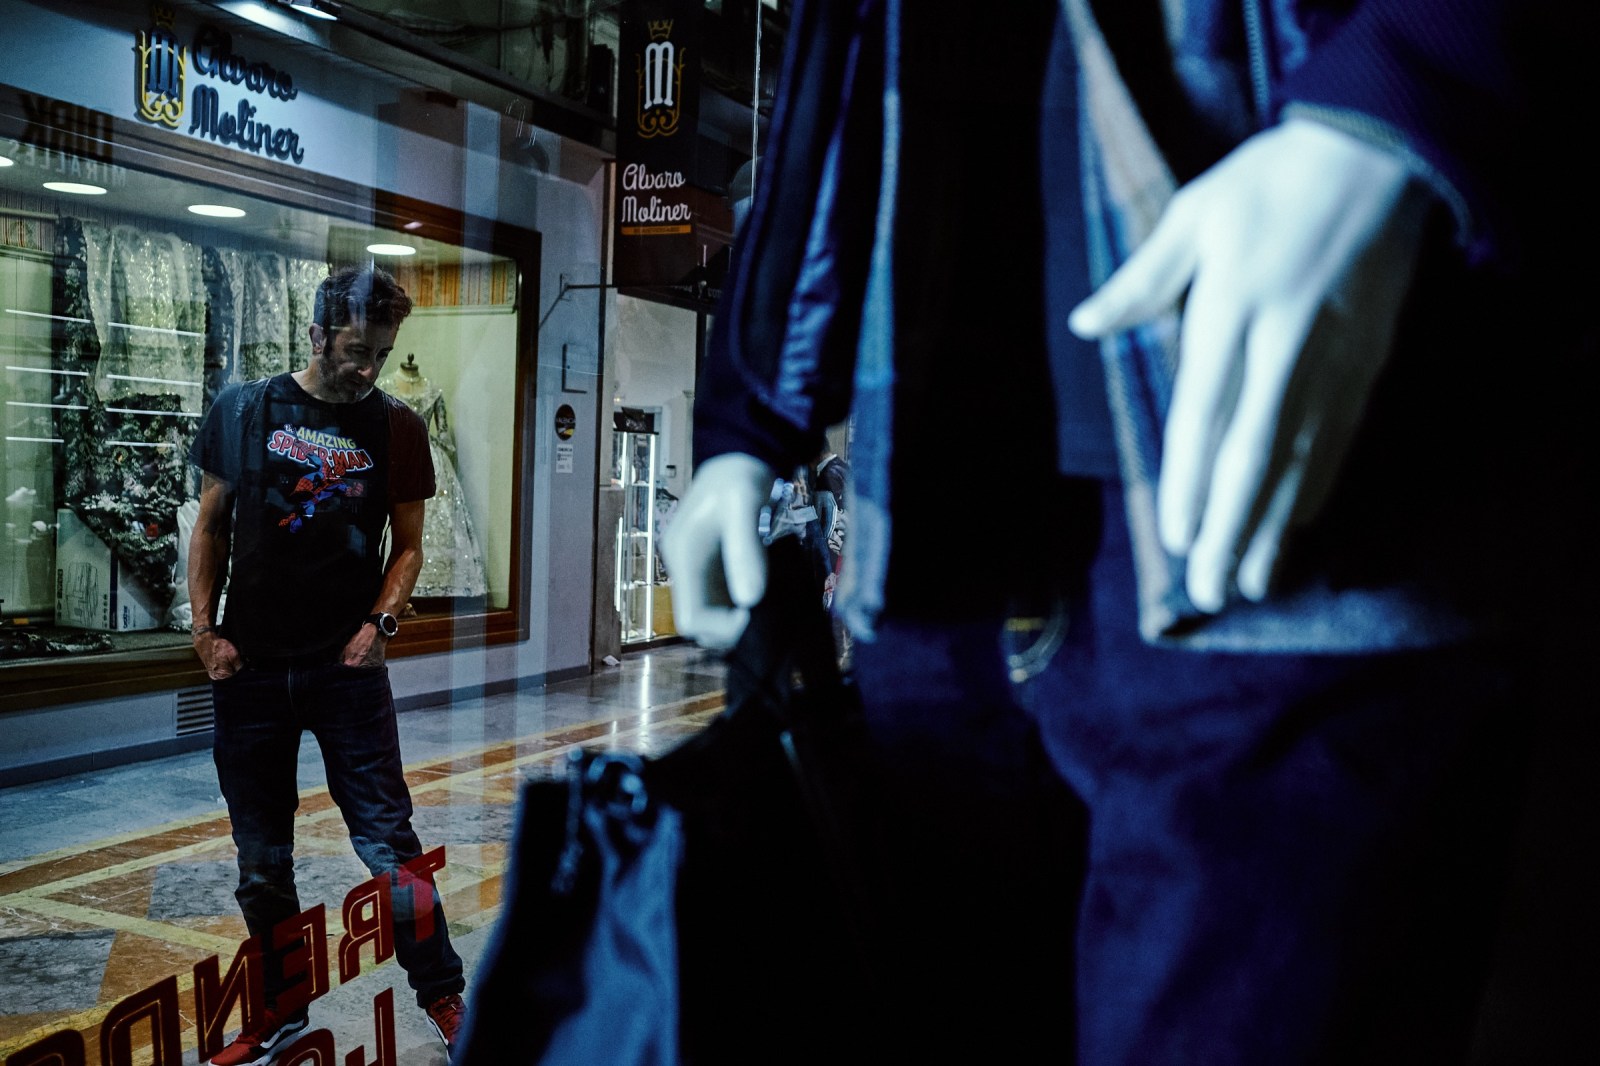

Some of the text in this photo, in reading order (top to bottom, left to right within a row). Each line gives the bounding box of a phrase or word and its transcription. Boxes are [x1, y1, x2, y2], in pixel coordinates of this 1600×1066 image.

[191, 24, 299, 102] Alvaro
[188, 84, 305, 165] Moliner
[622, 163, 686, 192] Alvaro
[621, 195, 691, 224] Moliner
[296, 426, 357, 449] AMAZING
